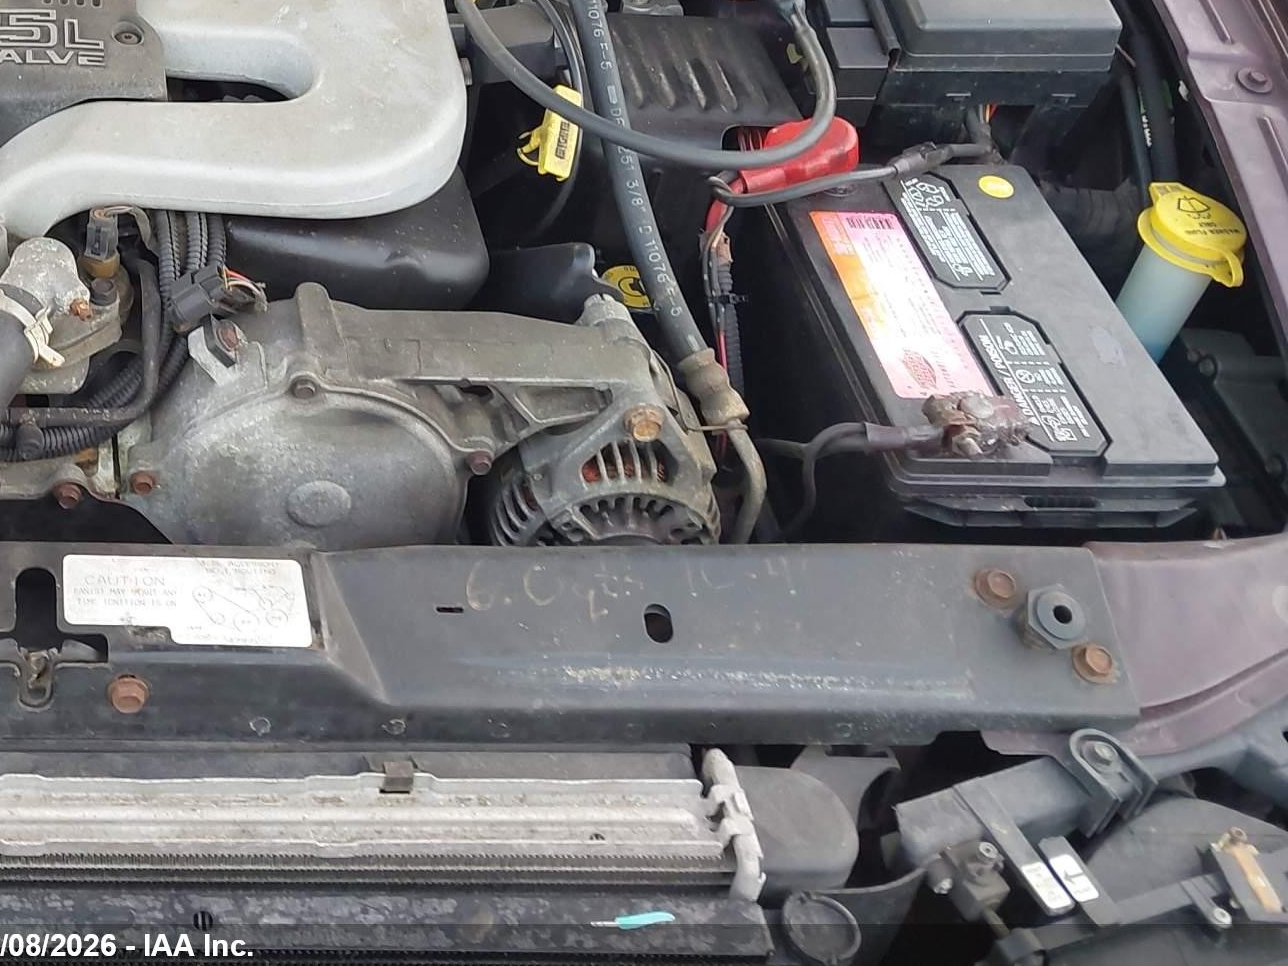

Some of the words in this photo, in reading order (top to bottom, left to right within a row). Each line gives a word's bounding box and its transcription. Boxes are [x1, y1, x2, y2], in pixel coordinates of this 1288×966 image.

[586, 0, 603, 37] 11076
[616, 146, 635, 171] 251
[642, 240, 670, 283] 11076
[979, 334, 1006, 368] POISON
[1004, 378, 1033, 416] DANGER
[84, 575, 165, 586] CAUTION
